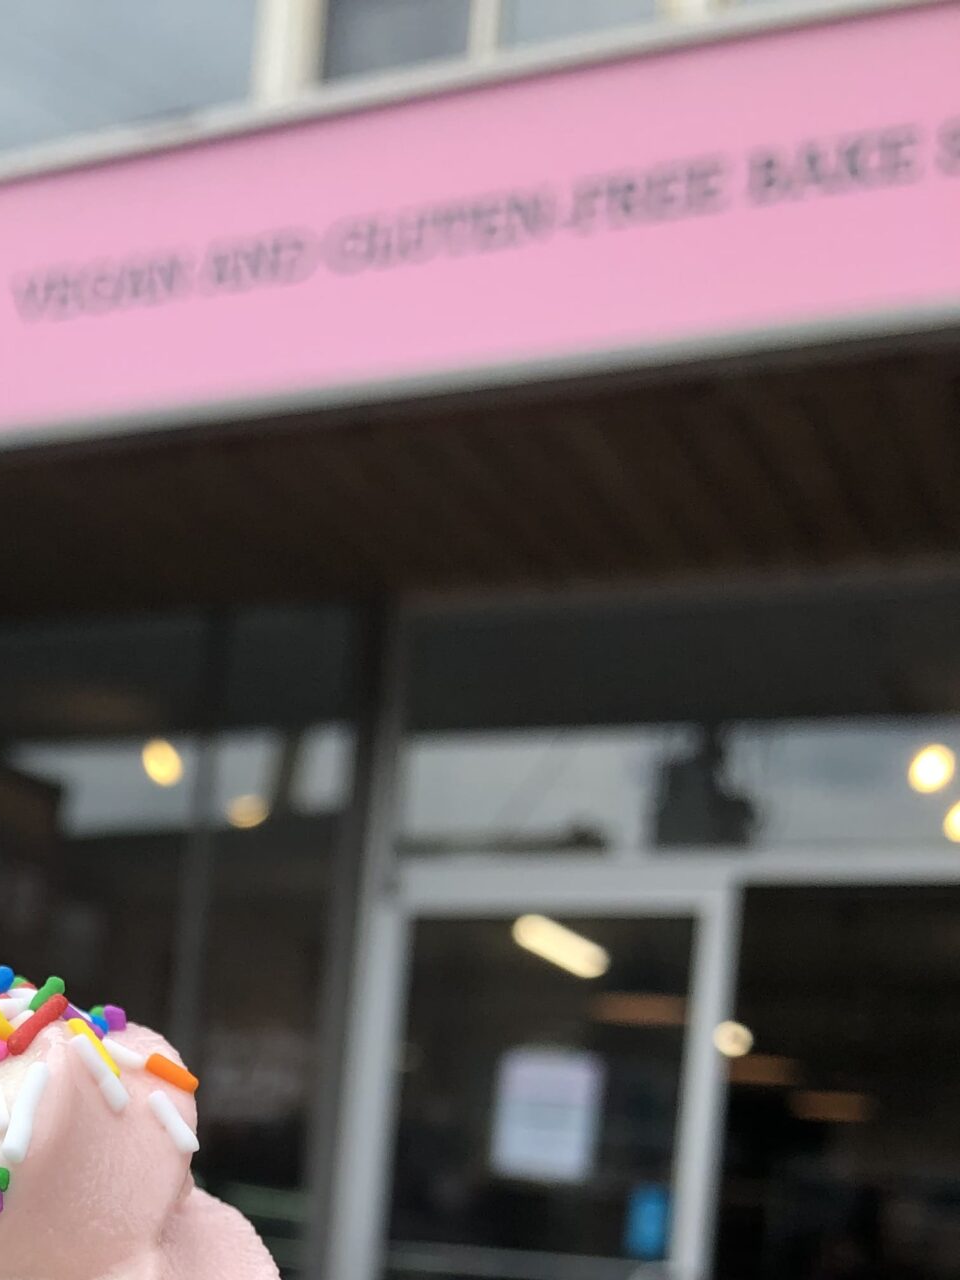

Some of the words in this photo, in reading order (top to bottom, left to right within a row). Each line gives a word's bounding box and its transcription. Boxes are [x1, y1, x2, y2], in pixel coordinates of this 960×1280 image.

[14, 248, 192, 322] VEGAN
[200, 228, 319, 297] AND
[746, 122, 922, 206] BAKE
